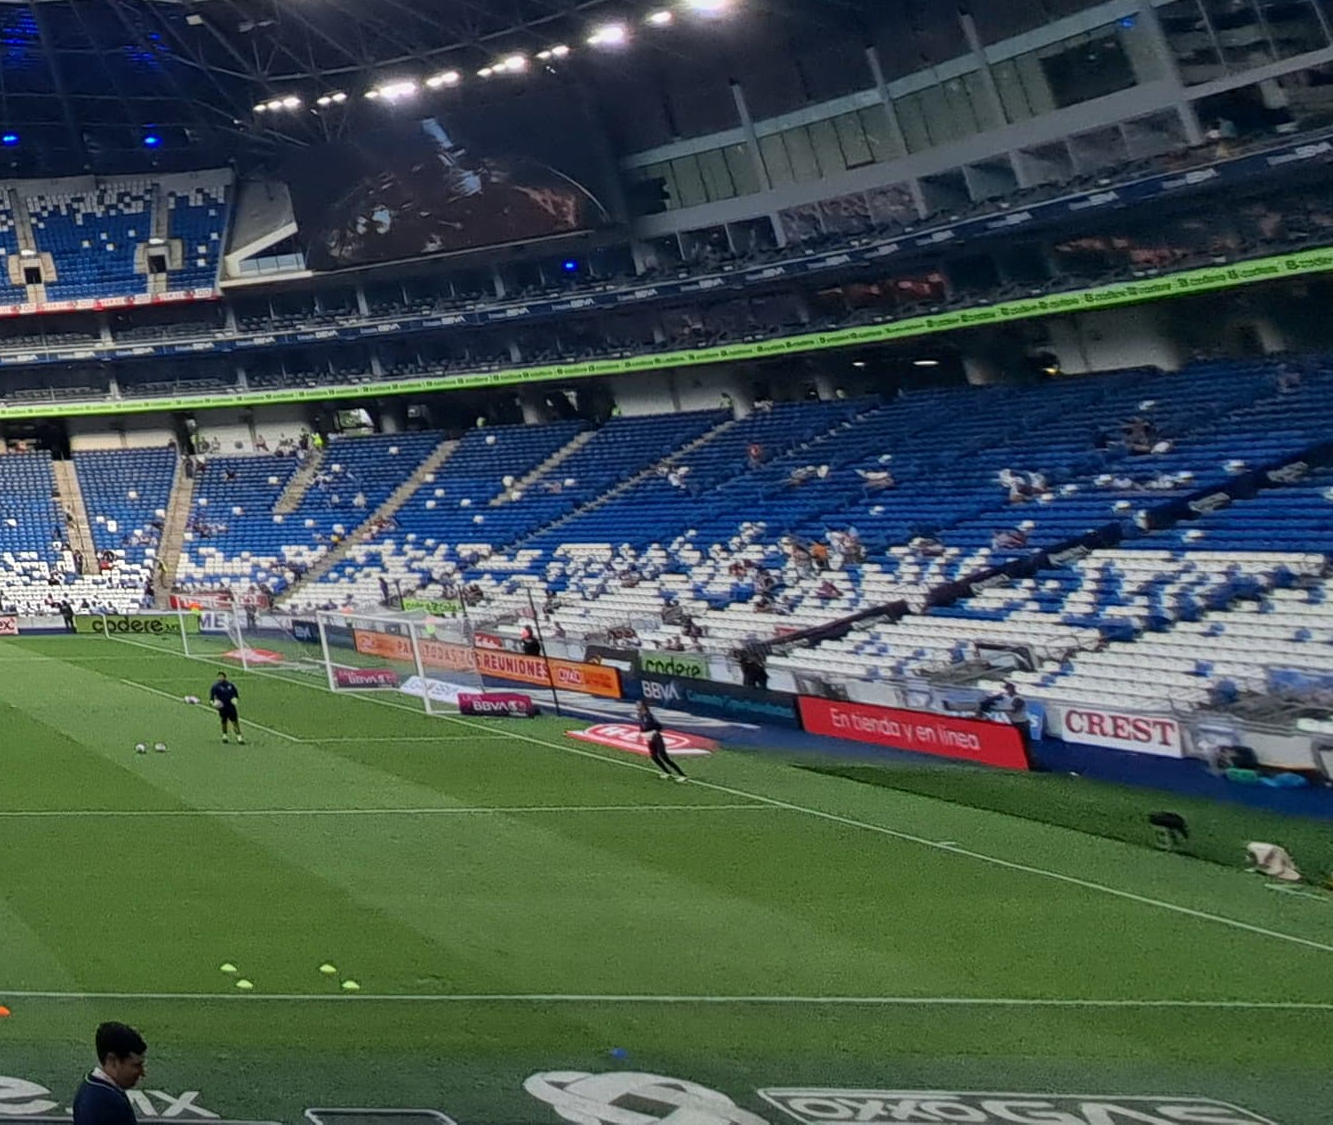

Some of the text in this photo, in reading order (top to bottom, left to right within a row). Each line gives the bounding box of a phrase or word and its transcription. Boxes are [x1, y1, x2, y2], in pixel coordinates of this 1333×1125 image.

[484, 653, 549, 679] REUNIONES
[641, 680, 680, 700] BBVA
[473, 700, 509, 712] BBVA
[830, 709, 849, 728] En
[851, 714, 901, 736] tienda
[905, 724, 913, 742] y
[915, 727, 935, 741] en
[1064, 709, 1176, 747] CREST
